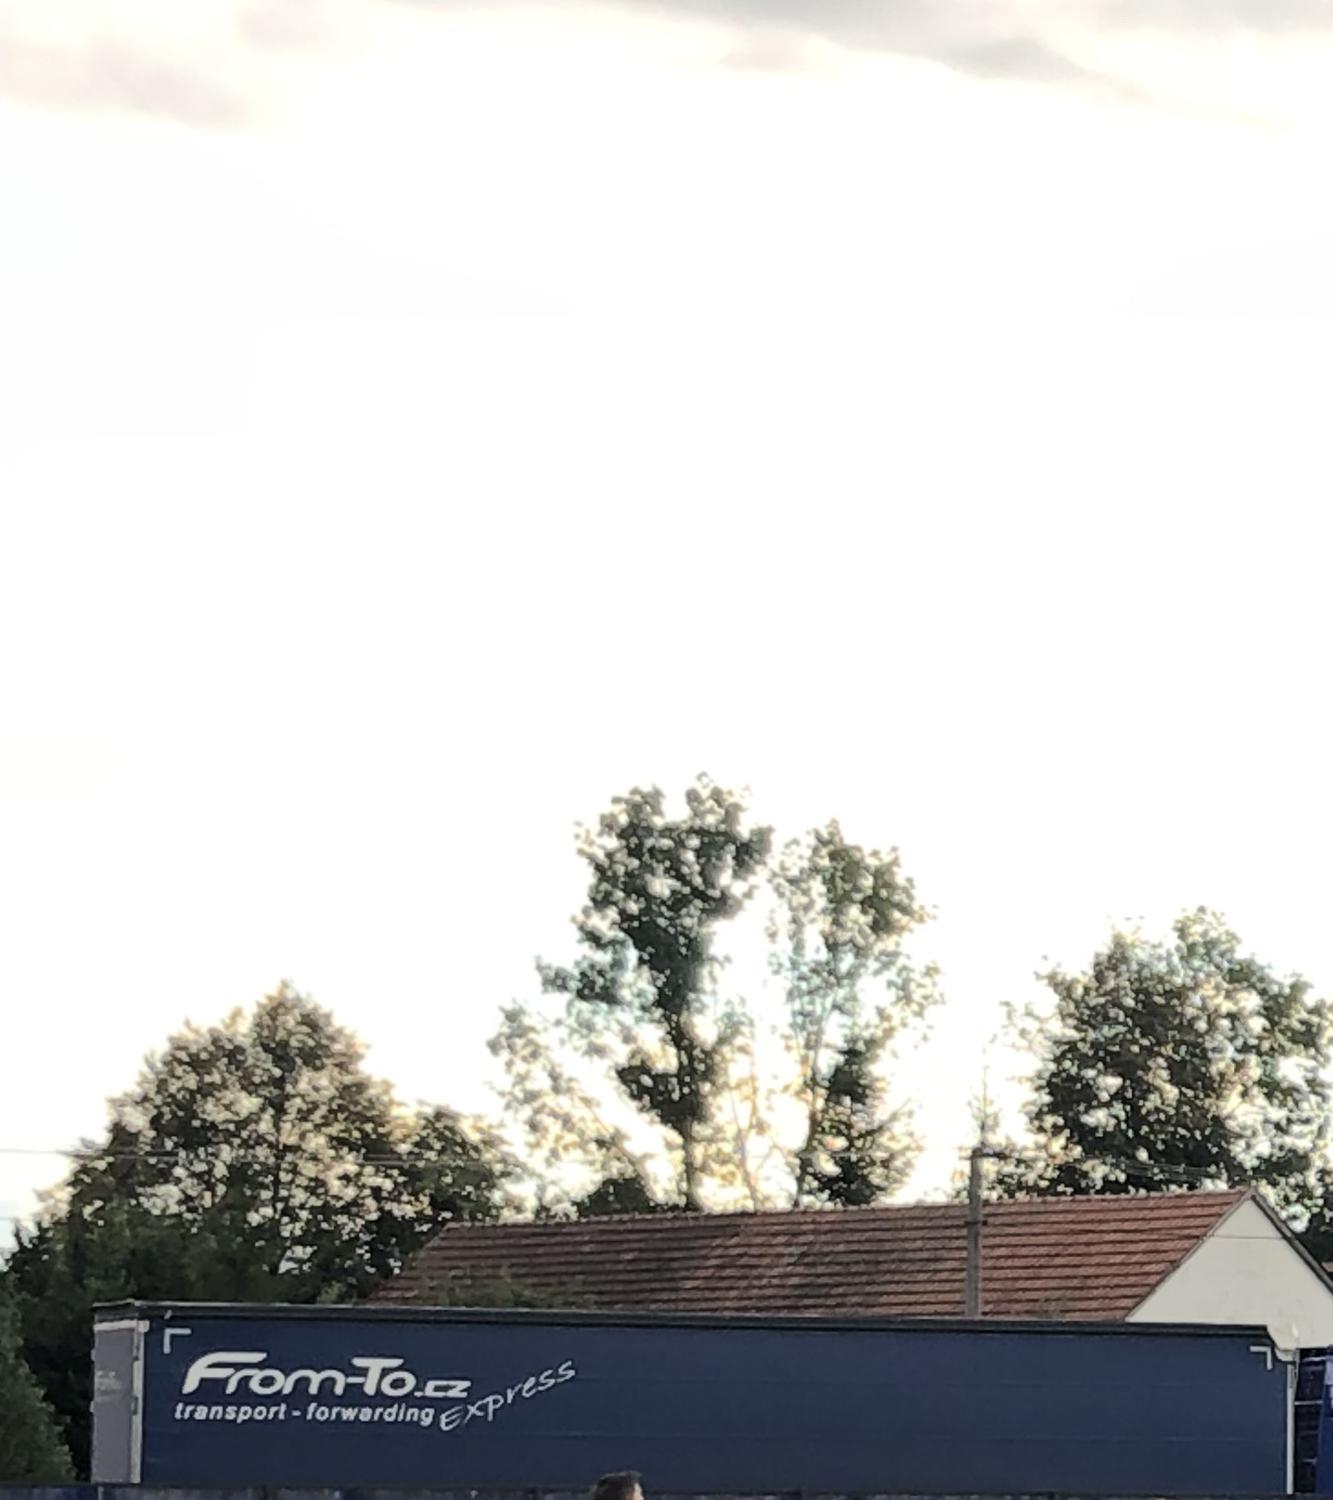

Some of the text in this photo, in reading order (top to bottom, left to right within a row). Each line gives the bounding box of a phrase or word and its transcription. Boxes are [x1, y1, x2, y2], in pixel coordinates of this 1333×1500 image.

[182, 1351, 472, 1397] From-To.cz
[174, 1403, 286, 1423] transport
[306, 1403, 435, 1426] forwarding
